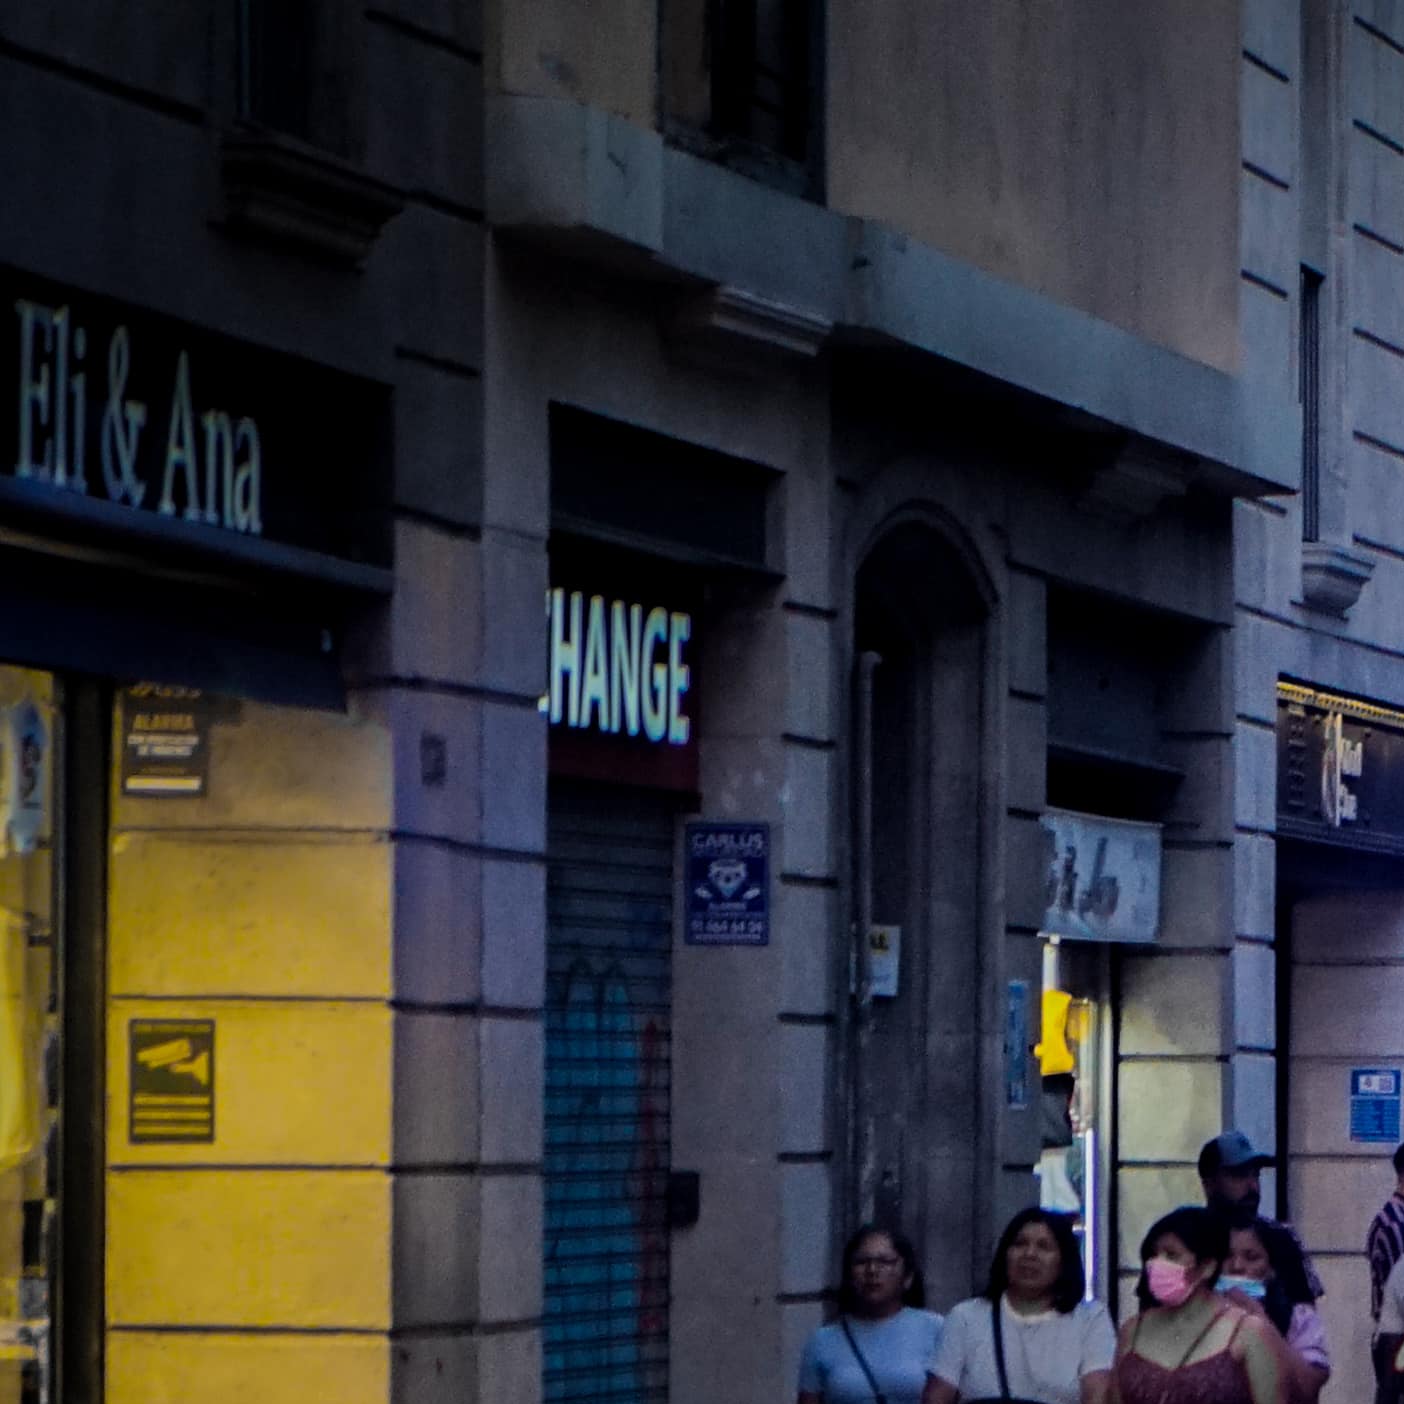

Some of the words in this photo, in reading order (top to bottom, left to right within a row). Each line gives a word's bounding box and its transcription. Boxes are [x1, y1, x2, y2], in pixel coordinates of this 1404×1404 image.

[13, 298, 89, 497] Eli
[100, 323, 149, 512] &
[157, 348, 264, 536] Ana
[538, 586, 692, 745] HANGE
